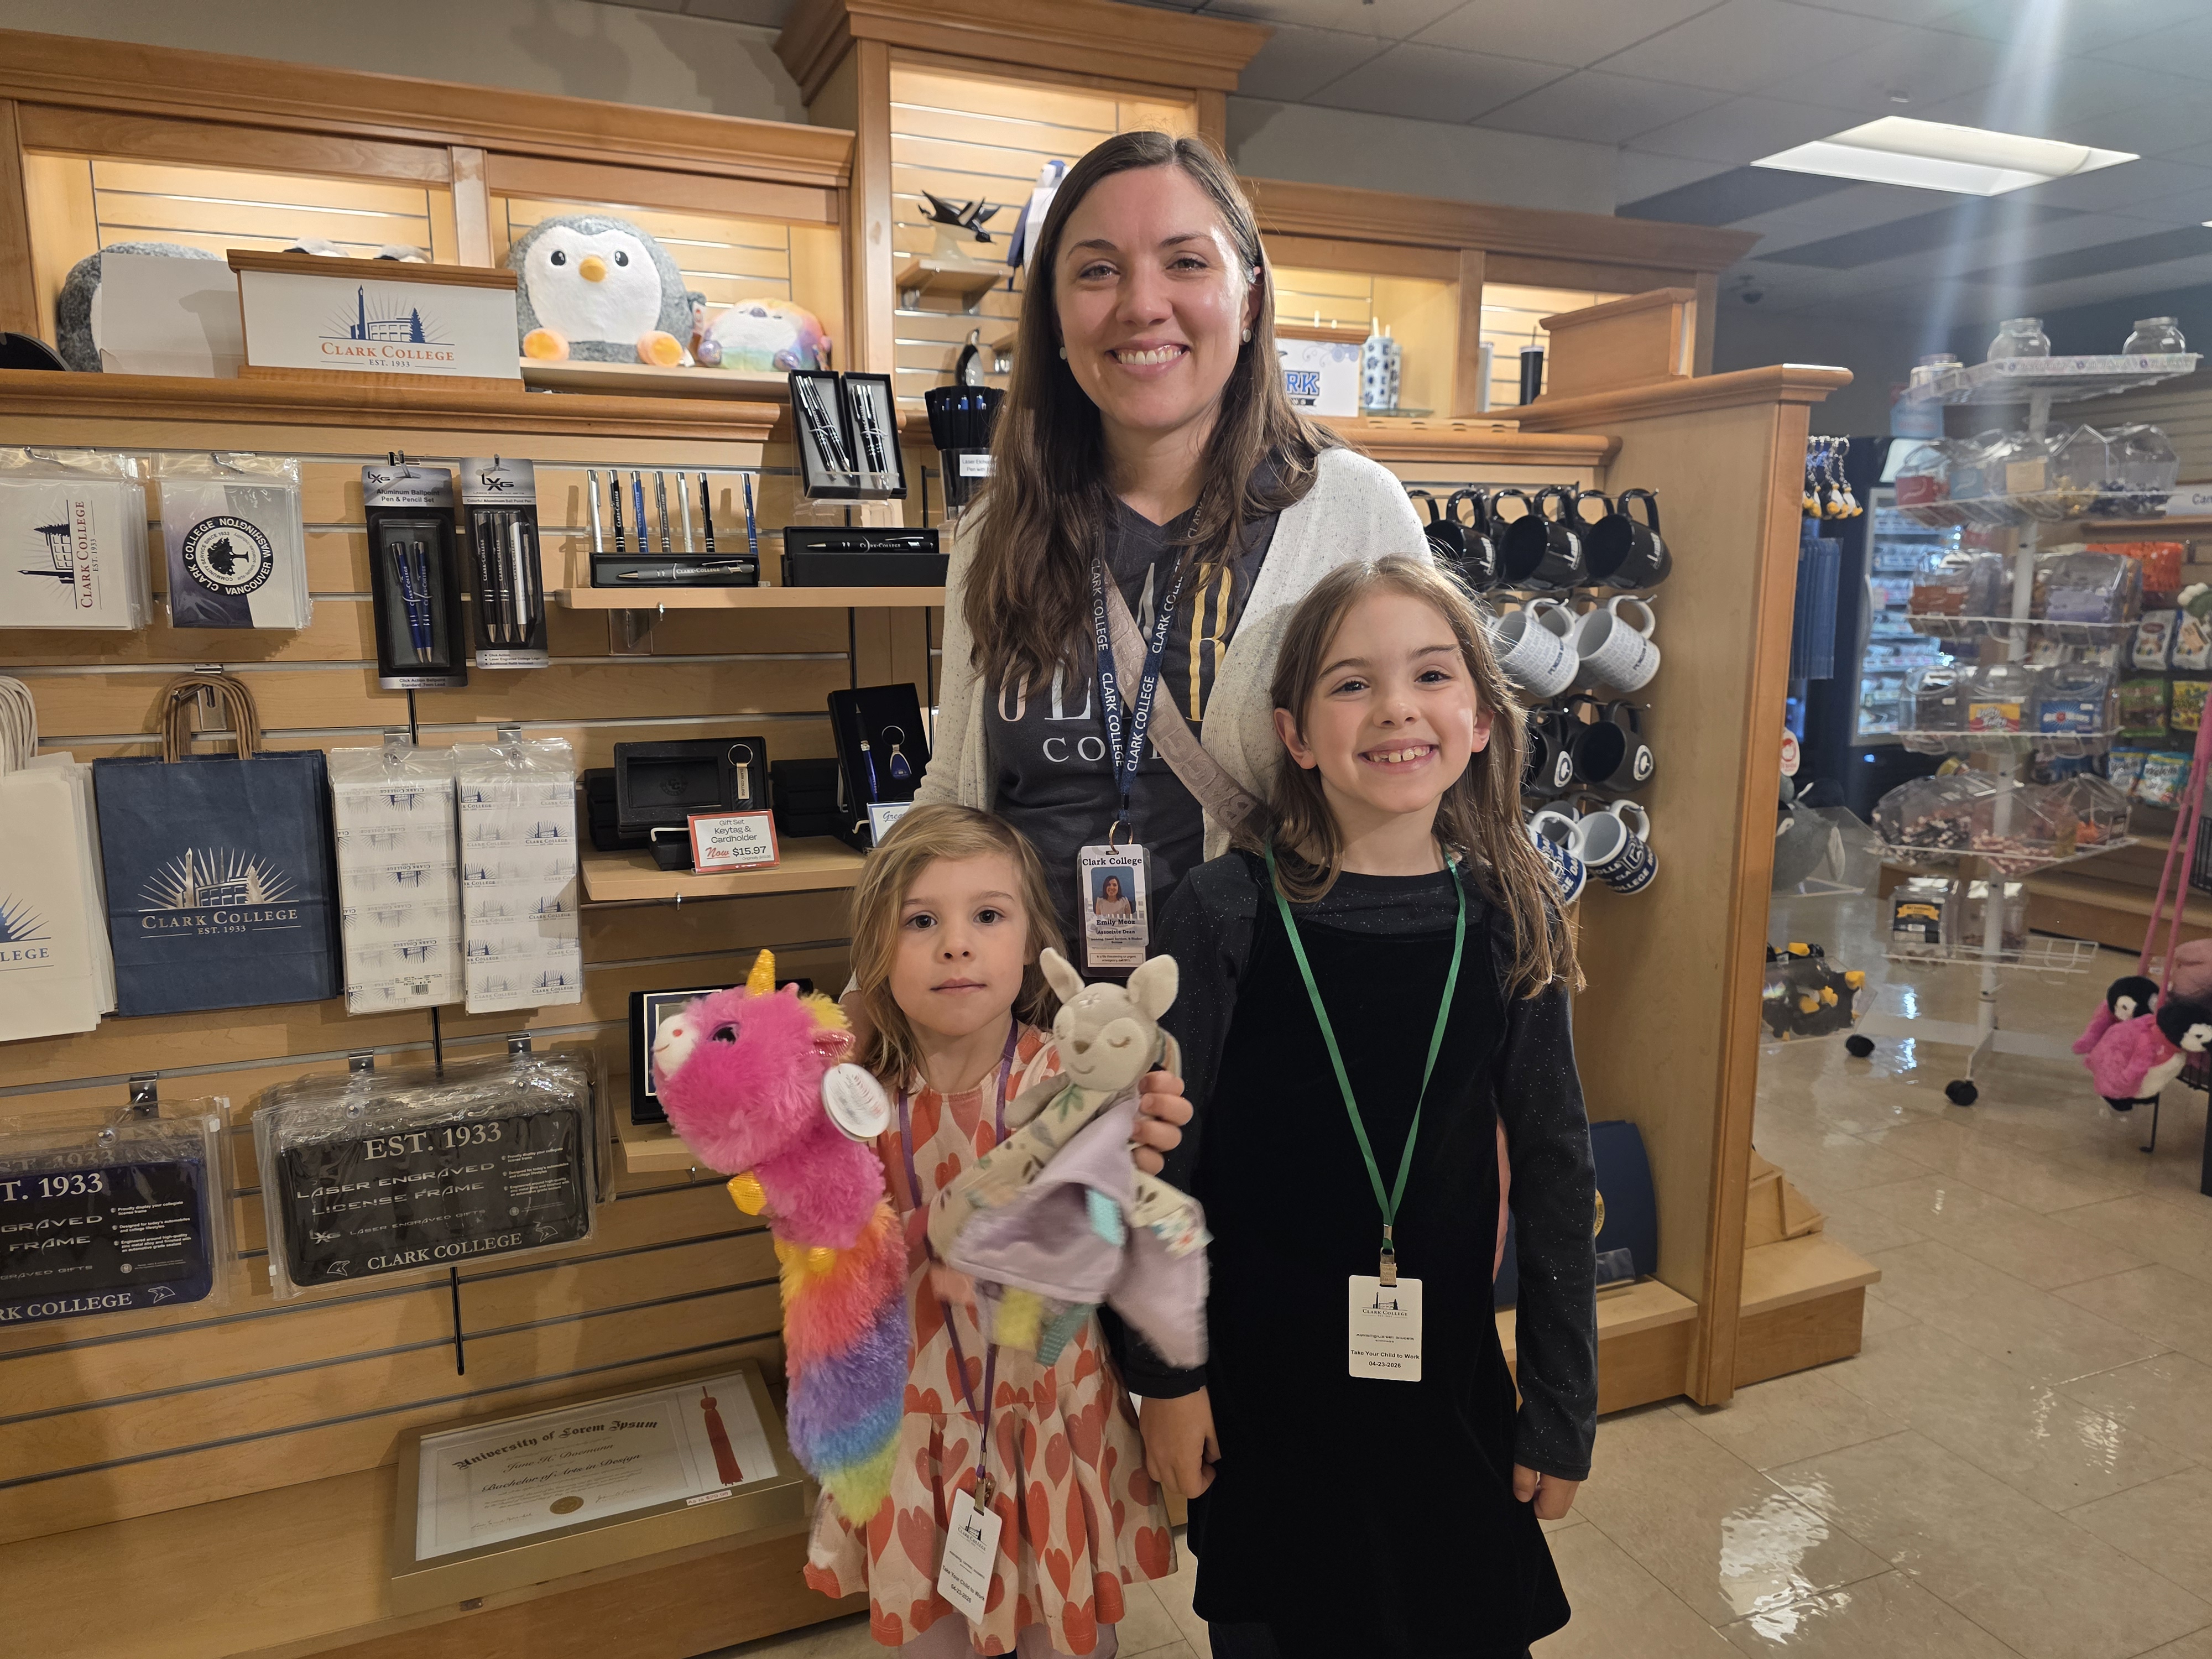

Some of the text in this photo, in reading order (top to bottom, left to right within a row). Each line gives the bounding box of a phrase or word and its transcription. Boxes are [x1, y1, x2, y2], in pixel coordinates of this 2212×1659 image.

[321, 342, 455, 361] CLARK COLLEGE
[204, 533, 218, 544] SINCE
[75, 501, 93, 608] CLARK COLLEGE
[185, 520, 219, 591] CLARK COLLEGE
[220, 518, 272, 595] VANCOUVER WASHINGTON
[204, 565, 233, 581] COMMUNITY
[403, 566, 411, 588] COLLEGE
[1091, 557, 1108, 651] CLARK COLLEGE
[1152, 614, 1171, 654] CLARK
[1102, 672, 1124, 767] CLARK COLLEGE
[1126, 676, 1155, 771] CLARK COLLEGE
[711, 834, 757, 843] Cardholder
[705, 846, 766, 858] Now $15.97
[1082, 857, 1142, 866] Clark College
[142, 909, 298, 930] CLARK COLLEGE
[197, 926, 220, 935] EST.
[363, 1121, 502, 1160] EST. 1933
[38, 1172, 103, 1198] 1933
[297, 1163, 495, 1203] LASER ENGRAVED
[312, 1182, 484, 1215] LICENSE FRAME
[1, 1215, 103, 1237] GRAVED
[350, 1225, 387, 1237] LASER
[392, 1215, 451, 1229] ENGRAVED
[9, 1236, 91, 1255] FRAME
[367, 1233, 522, 1270] CLARK COLLEGE
[27, 1292, 132, 1317] COLLEGE
[452, 1437, 538, 1471] University
[542, 1431, 555, 1441] of
[559, 1423, 604, 1438] Lorem
[609, 1420, 658, 1431] Ipsum
[482, 1476, 539, 1493] Bachelor
[540, 1470, 557, 1482] of
[600, 1453, 641, 1467] Design
[969, 1536, 986, 1551] COLLEGE
[942, 1565, 951, 1574] Take
